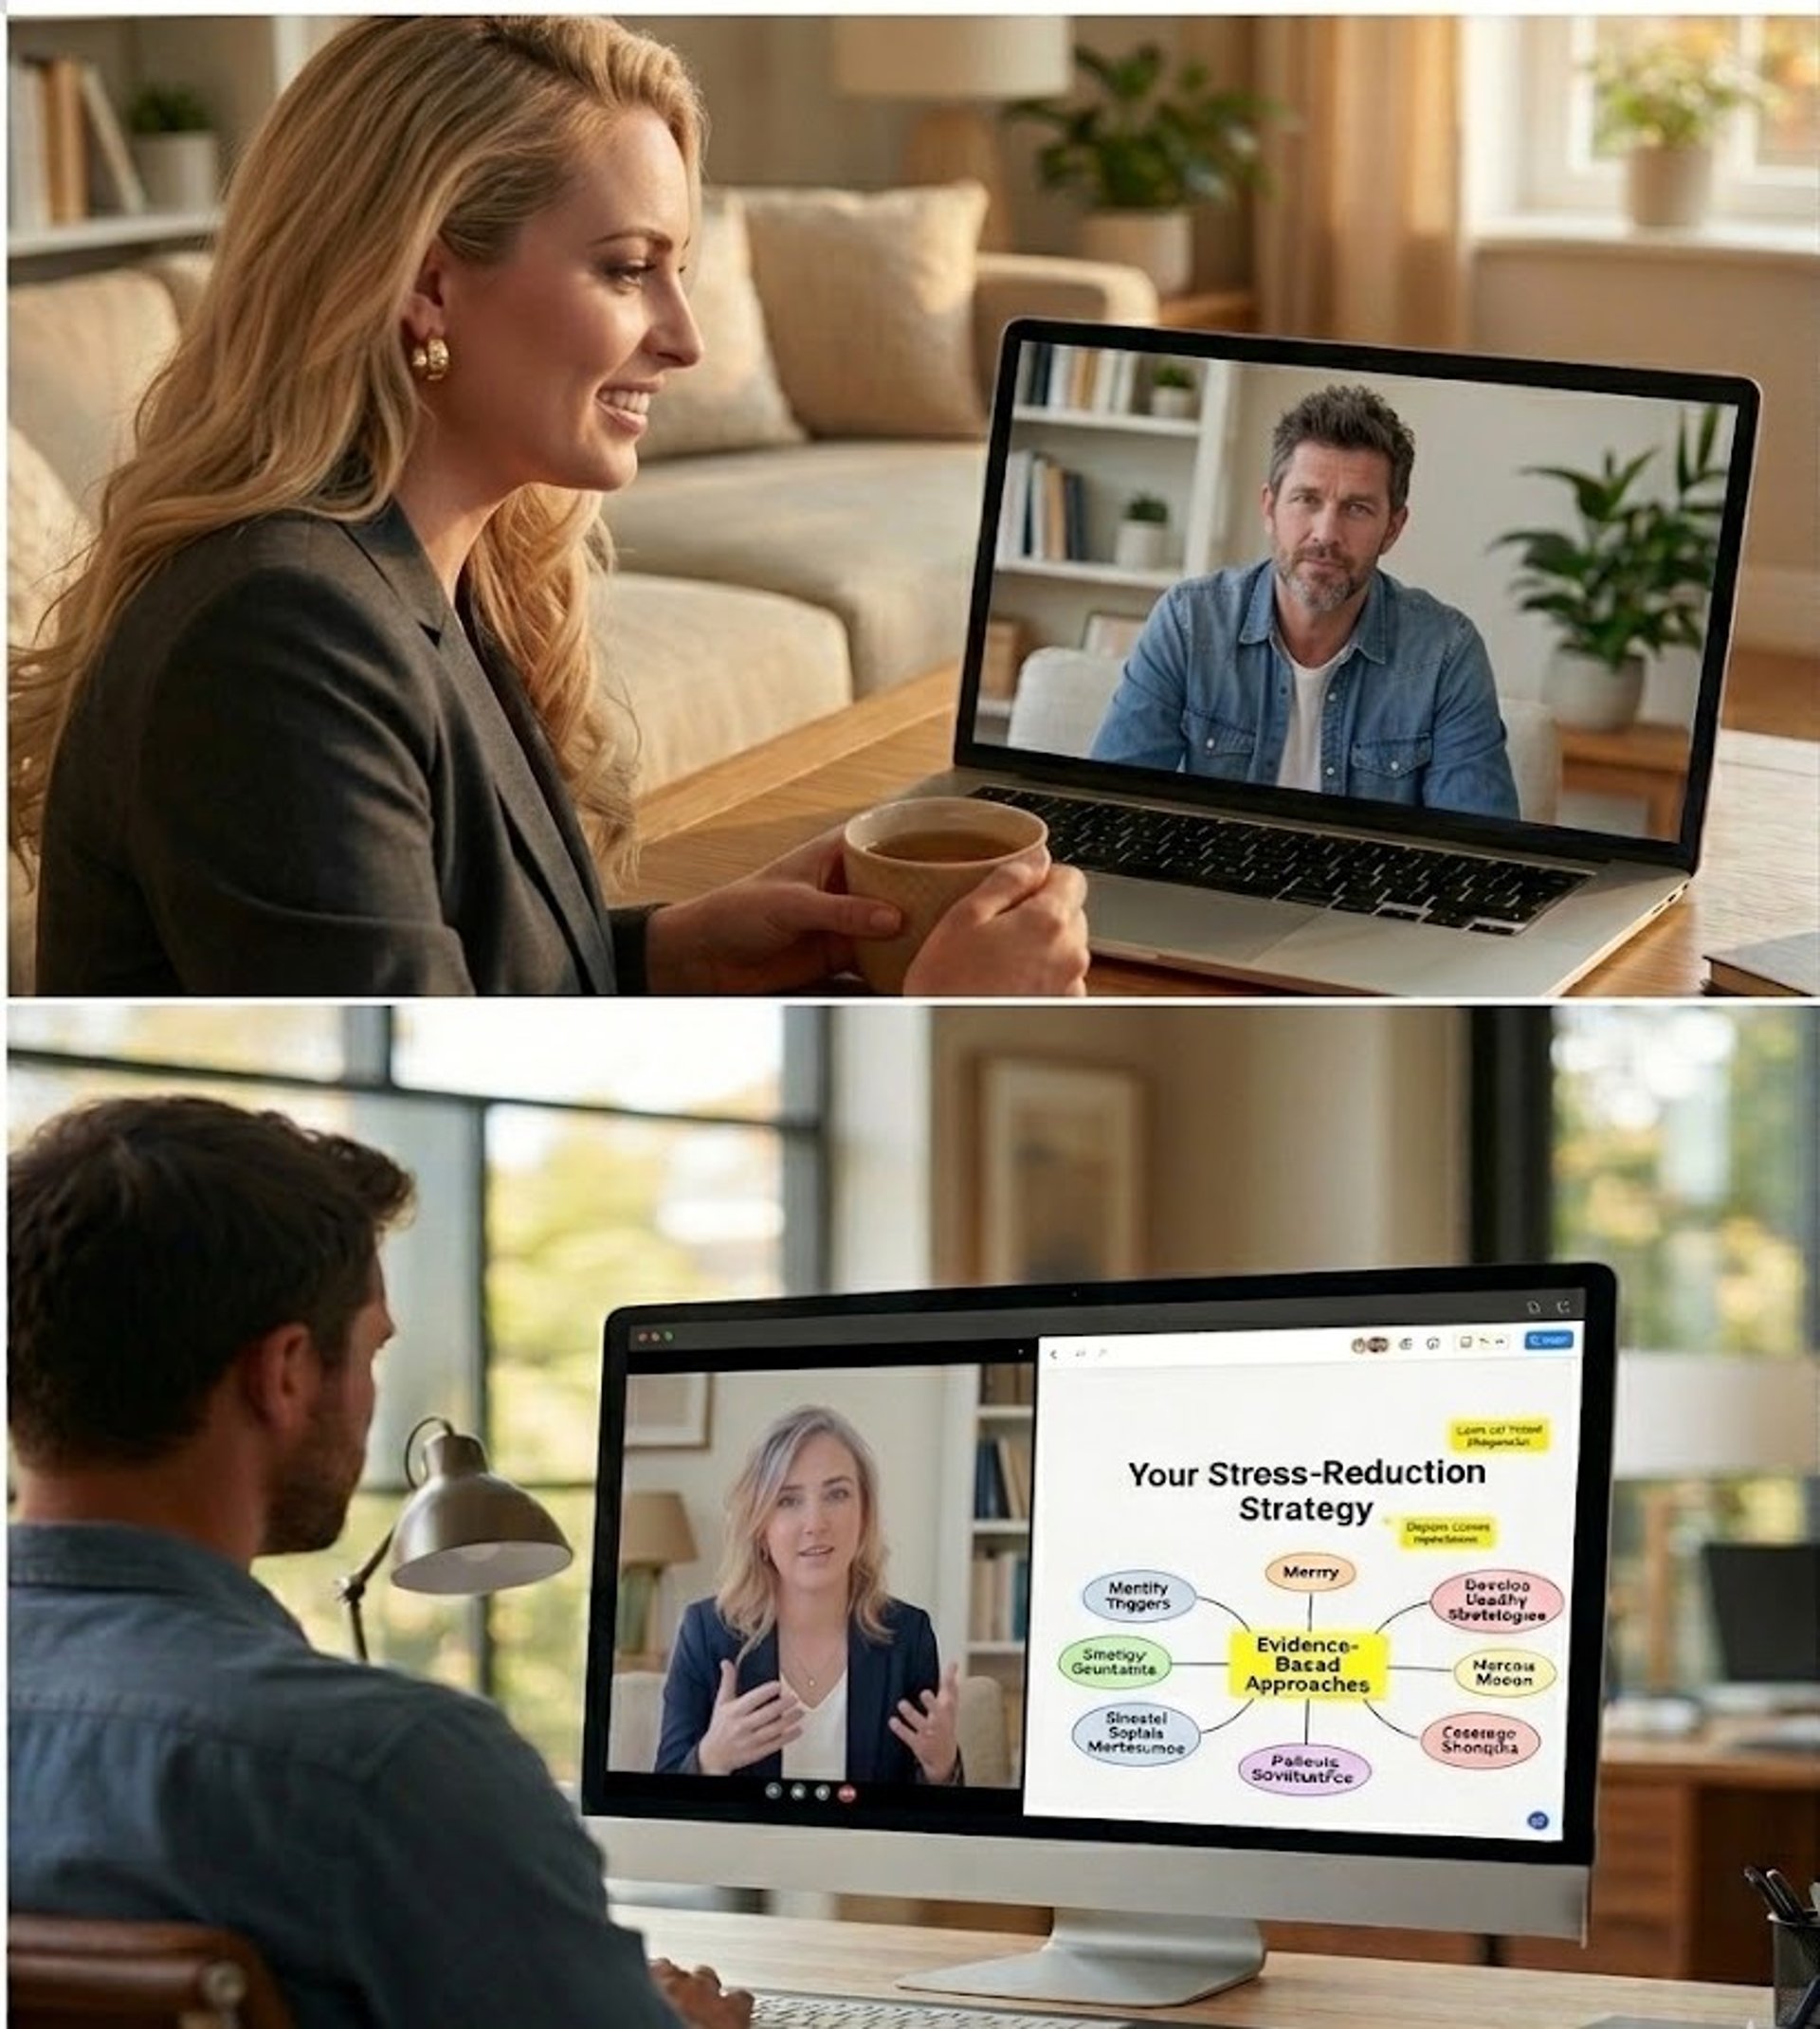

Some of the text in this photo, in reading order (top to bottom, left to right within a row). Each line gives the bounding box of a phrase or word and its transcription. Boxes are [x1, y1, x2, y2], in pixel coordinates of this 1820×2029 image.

[1129, 1459, 1486, 1487] Your Stress-Reduction
[1239, 1496, 1374, 1526] Strategy
[1257, 1636, 1359, 1653] Evidence-
[1245, 1675, 1371, 1695] Approaches
